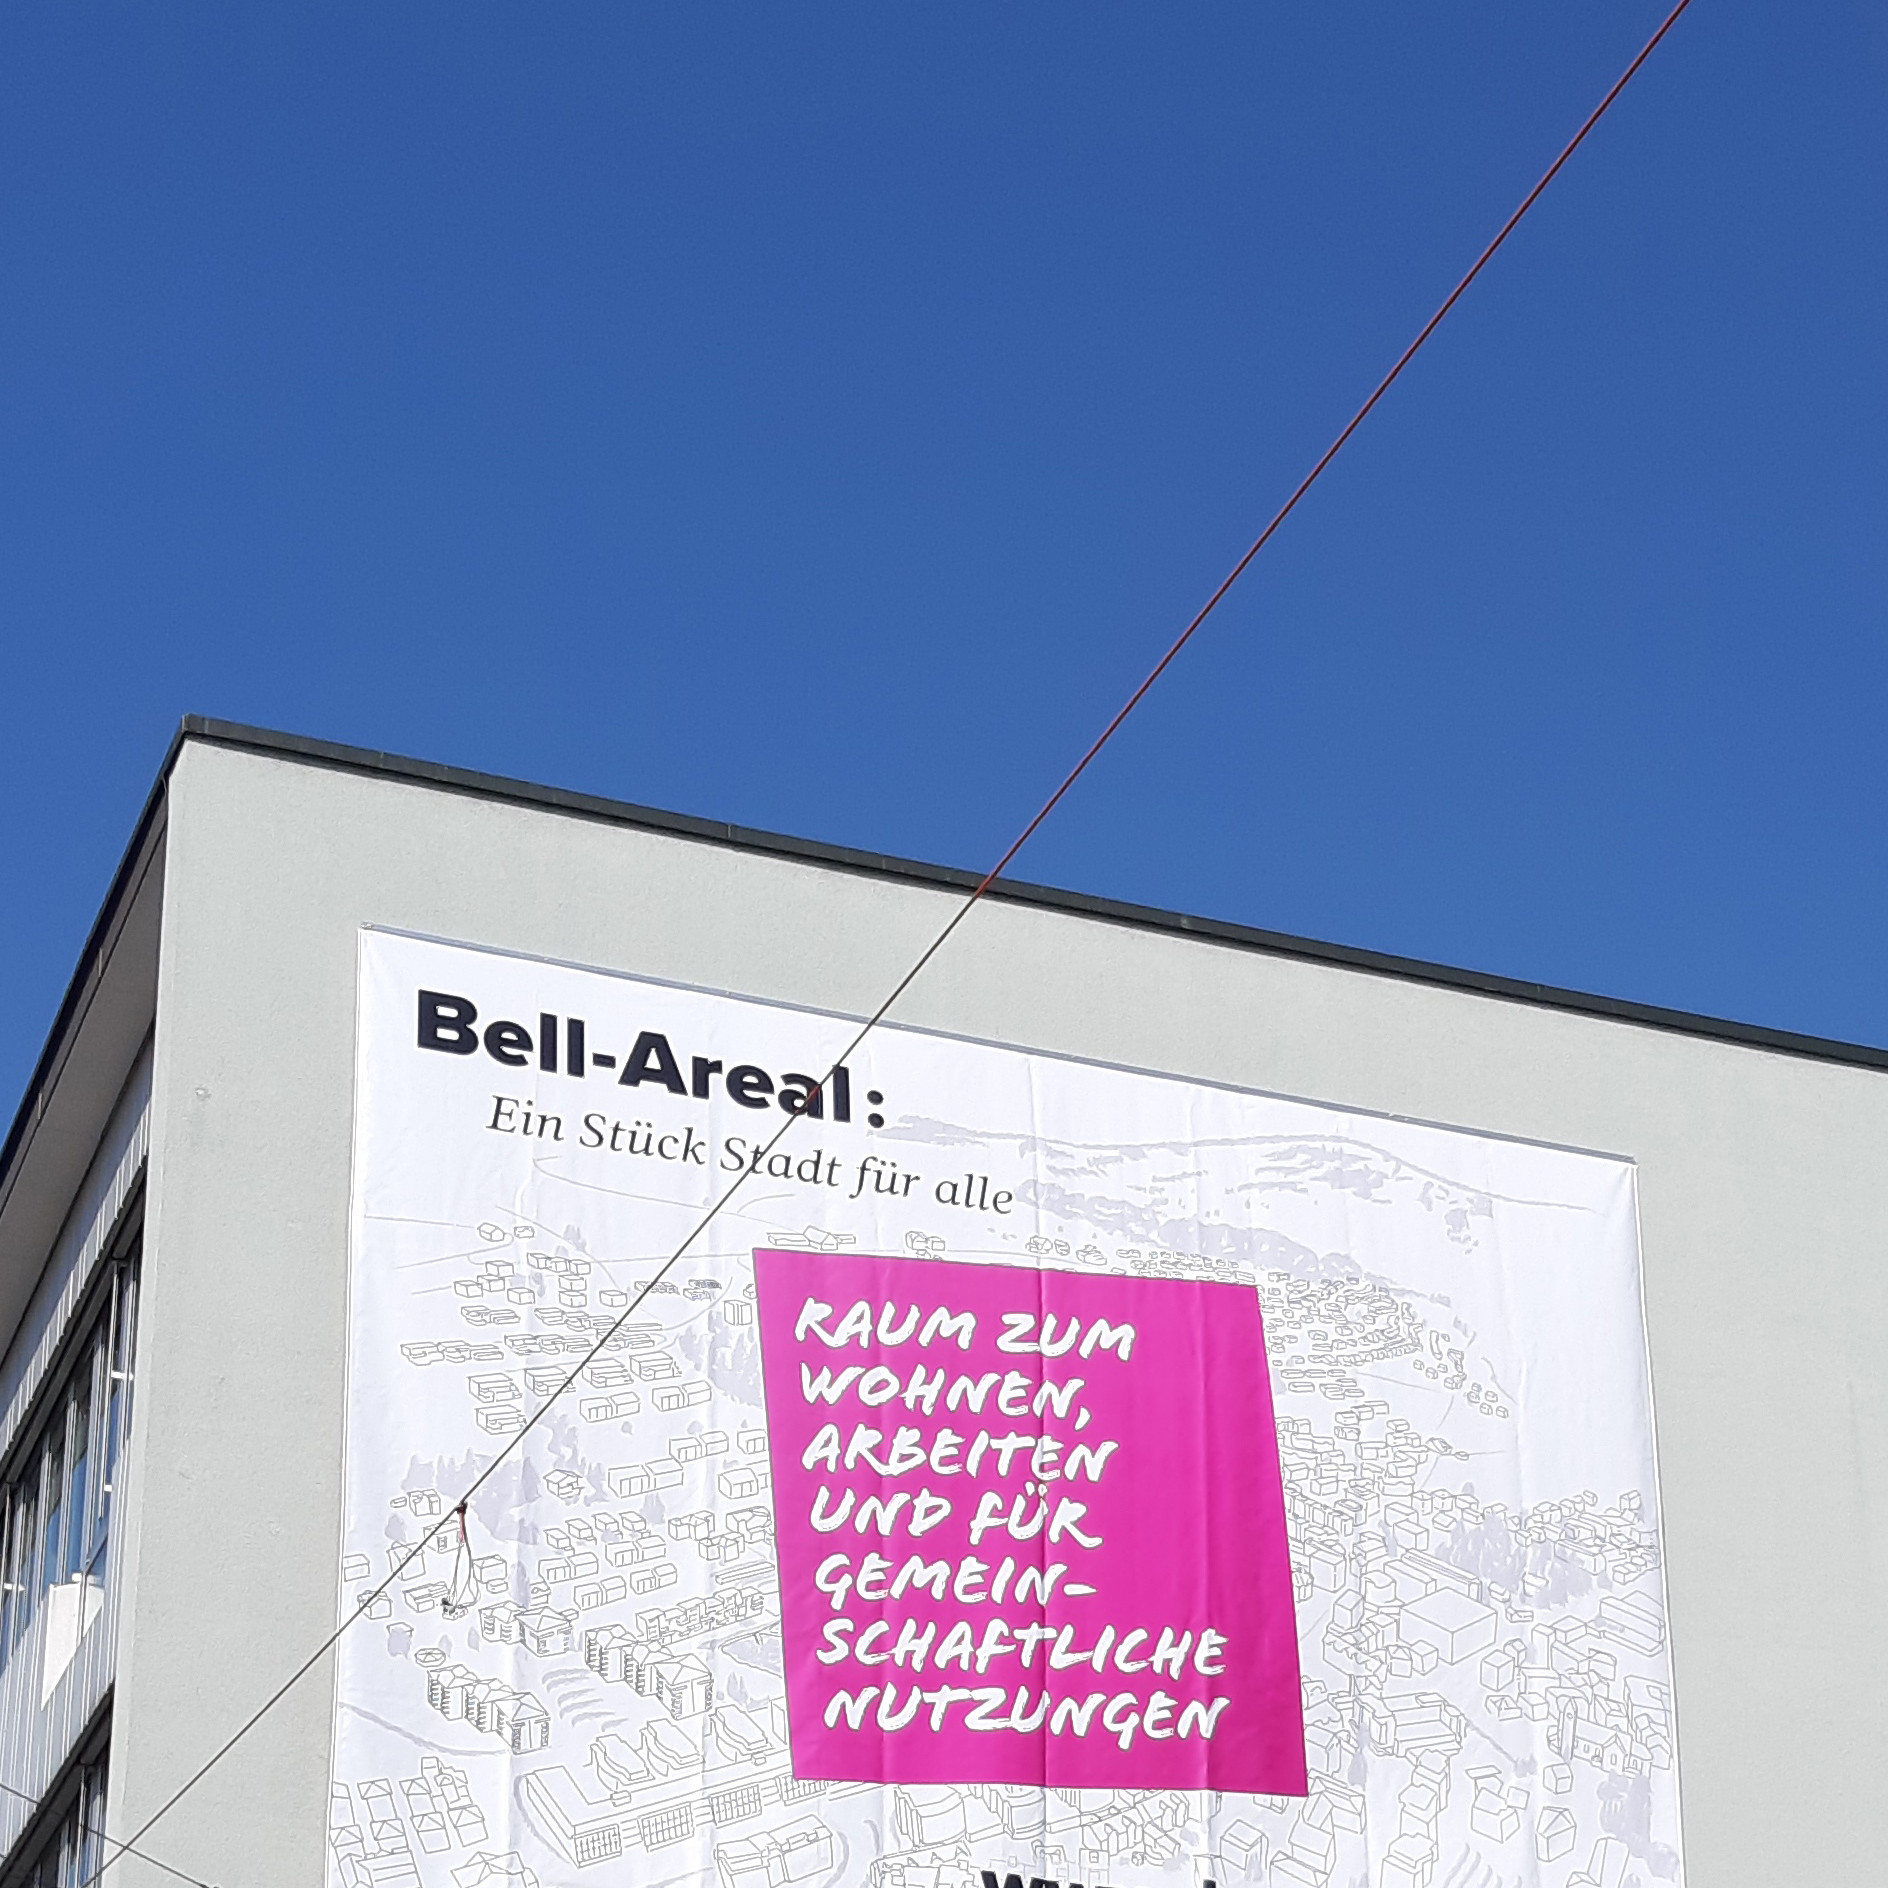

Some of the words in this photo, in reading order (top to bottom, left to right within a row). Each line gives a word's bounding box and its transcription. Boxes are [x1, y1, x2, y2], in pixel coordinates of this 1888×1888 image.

[417, 991, 887, 1130] Bell-Areal:
[487, 1096, 563, 1141] Ein
[580, 1111, 710, 1165] Stück
[721, 1136, 843, 1188] Stadt
[849, 1156, 921, 1199] für
[935, 1173, 1014, 1214] alle
[795, 1297, 977, 1350] RAUM
[996, 1313, 1136, 1361] ZUM
[802, 1363, 1091, 1429] WOHNEN,
[802, 1423, 1118, 1482] ARBEITEN
[811, 1486, 952, 1537] UND
[970, 1481, 1103, 1549] FÜR
[816, 1553, 1097, 1609] GEMEIN-
[816, 1618, 1228, 1681] SCHAFTLICHE
[823, 1682, 1231, 1750] NUTZUNGEN
